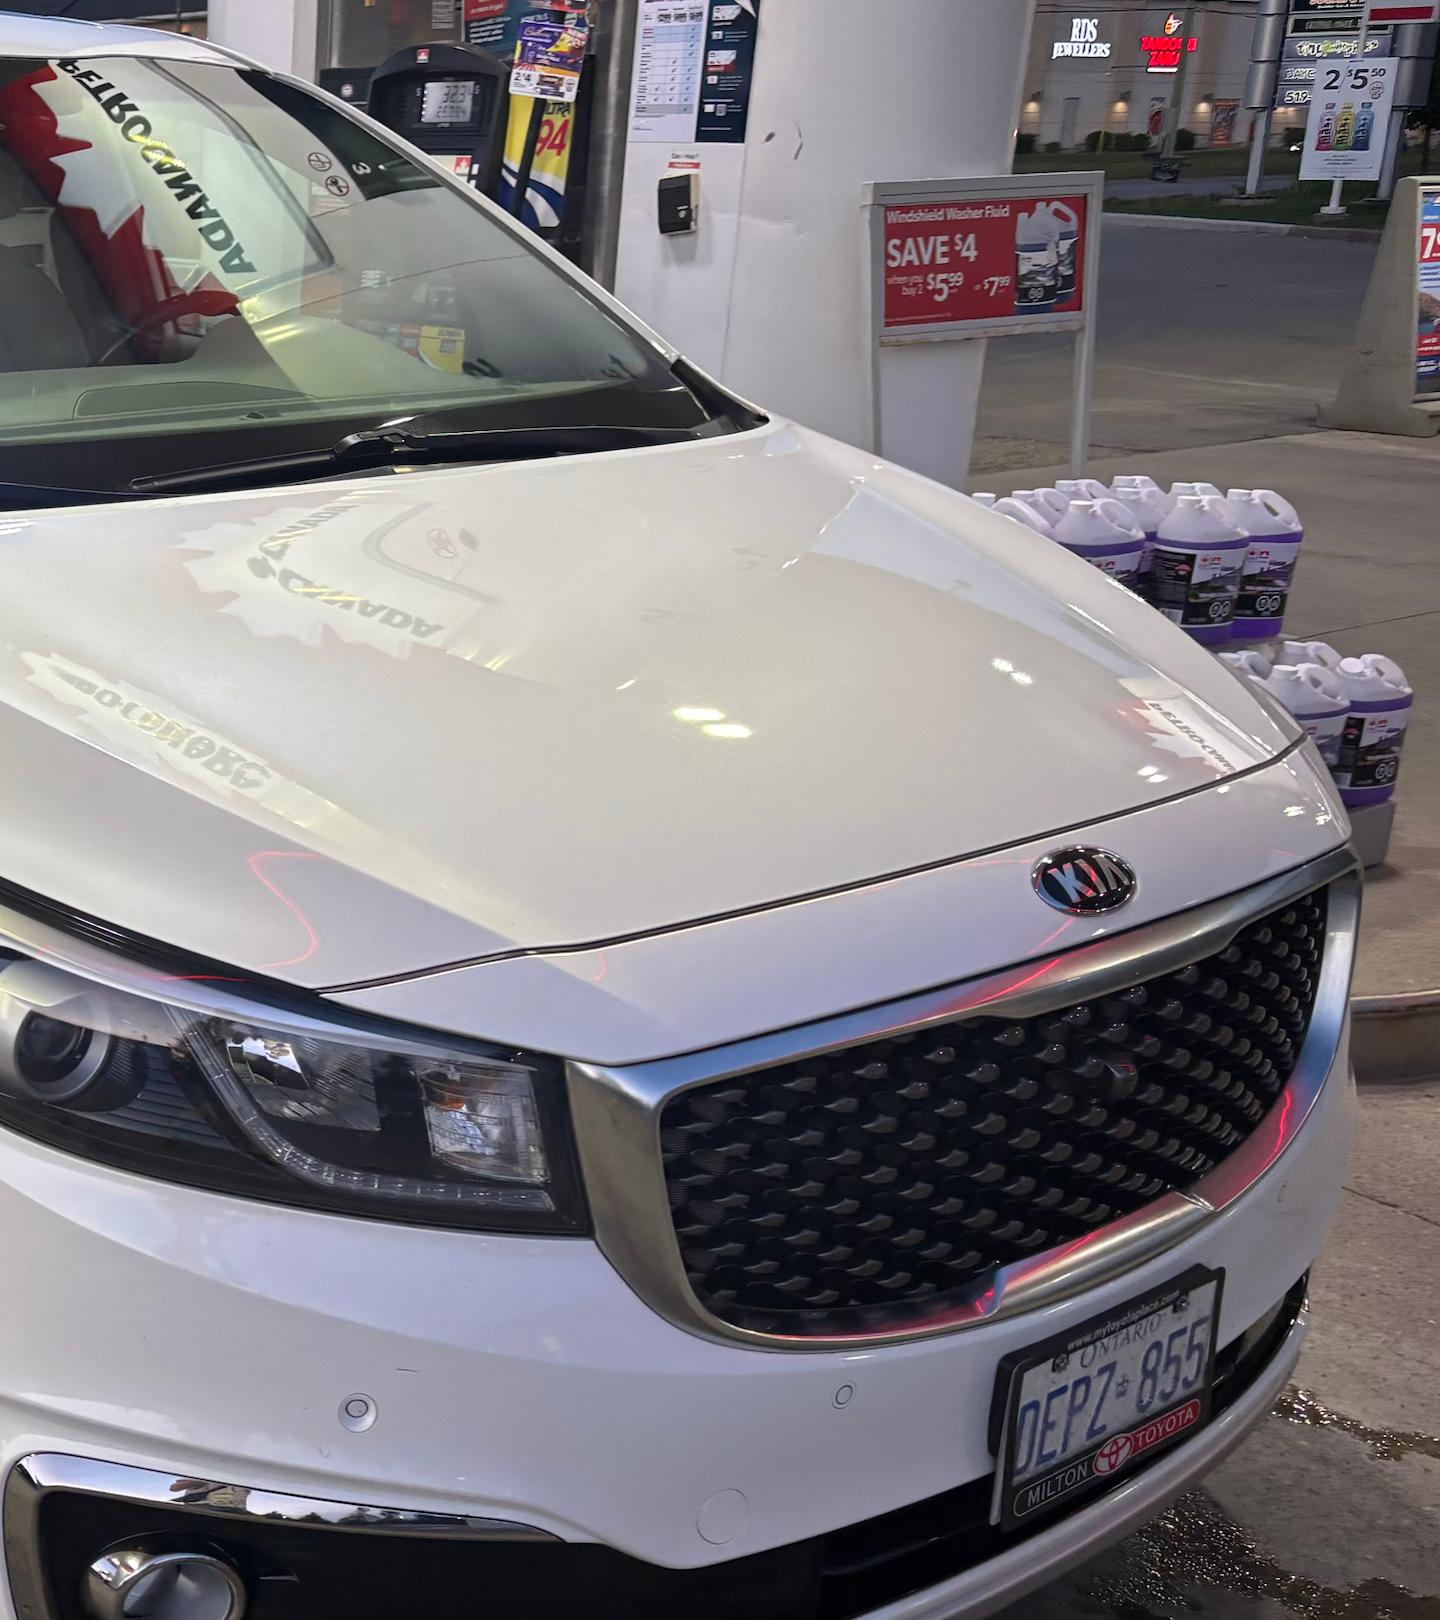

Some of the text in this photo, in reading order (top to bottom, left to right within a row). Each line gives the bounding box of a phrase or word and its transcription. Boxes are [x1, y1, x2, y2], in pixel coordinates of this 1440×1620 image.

[1070, 18, 1099, 43] RDS
[1051, 42, 1111, 60] JEWELLERS
[535, 118, 570, 157] 94
[887, 204, 1010, 224] Windshield Washer Fluid
[887, 233, 978, 268] SAVE $4
[1047, 854, 1130, 904] KIA
[1080, 1313, 1162, 1369] ONTARIO
[1012, 1315, 1209, 1479] DEPZ 855
[1026, 1406, 1195, 1507] MILTON TOYOTA
